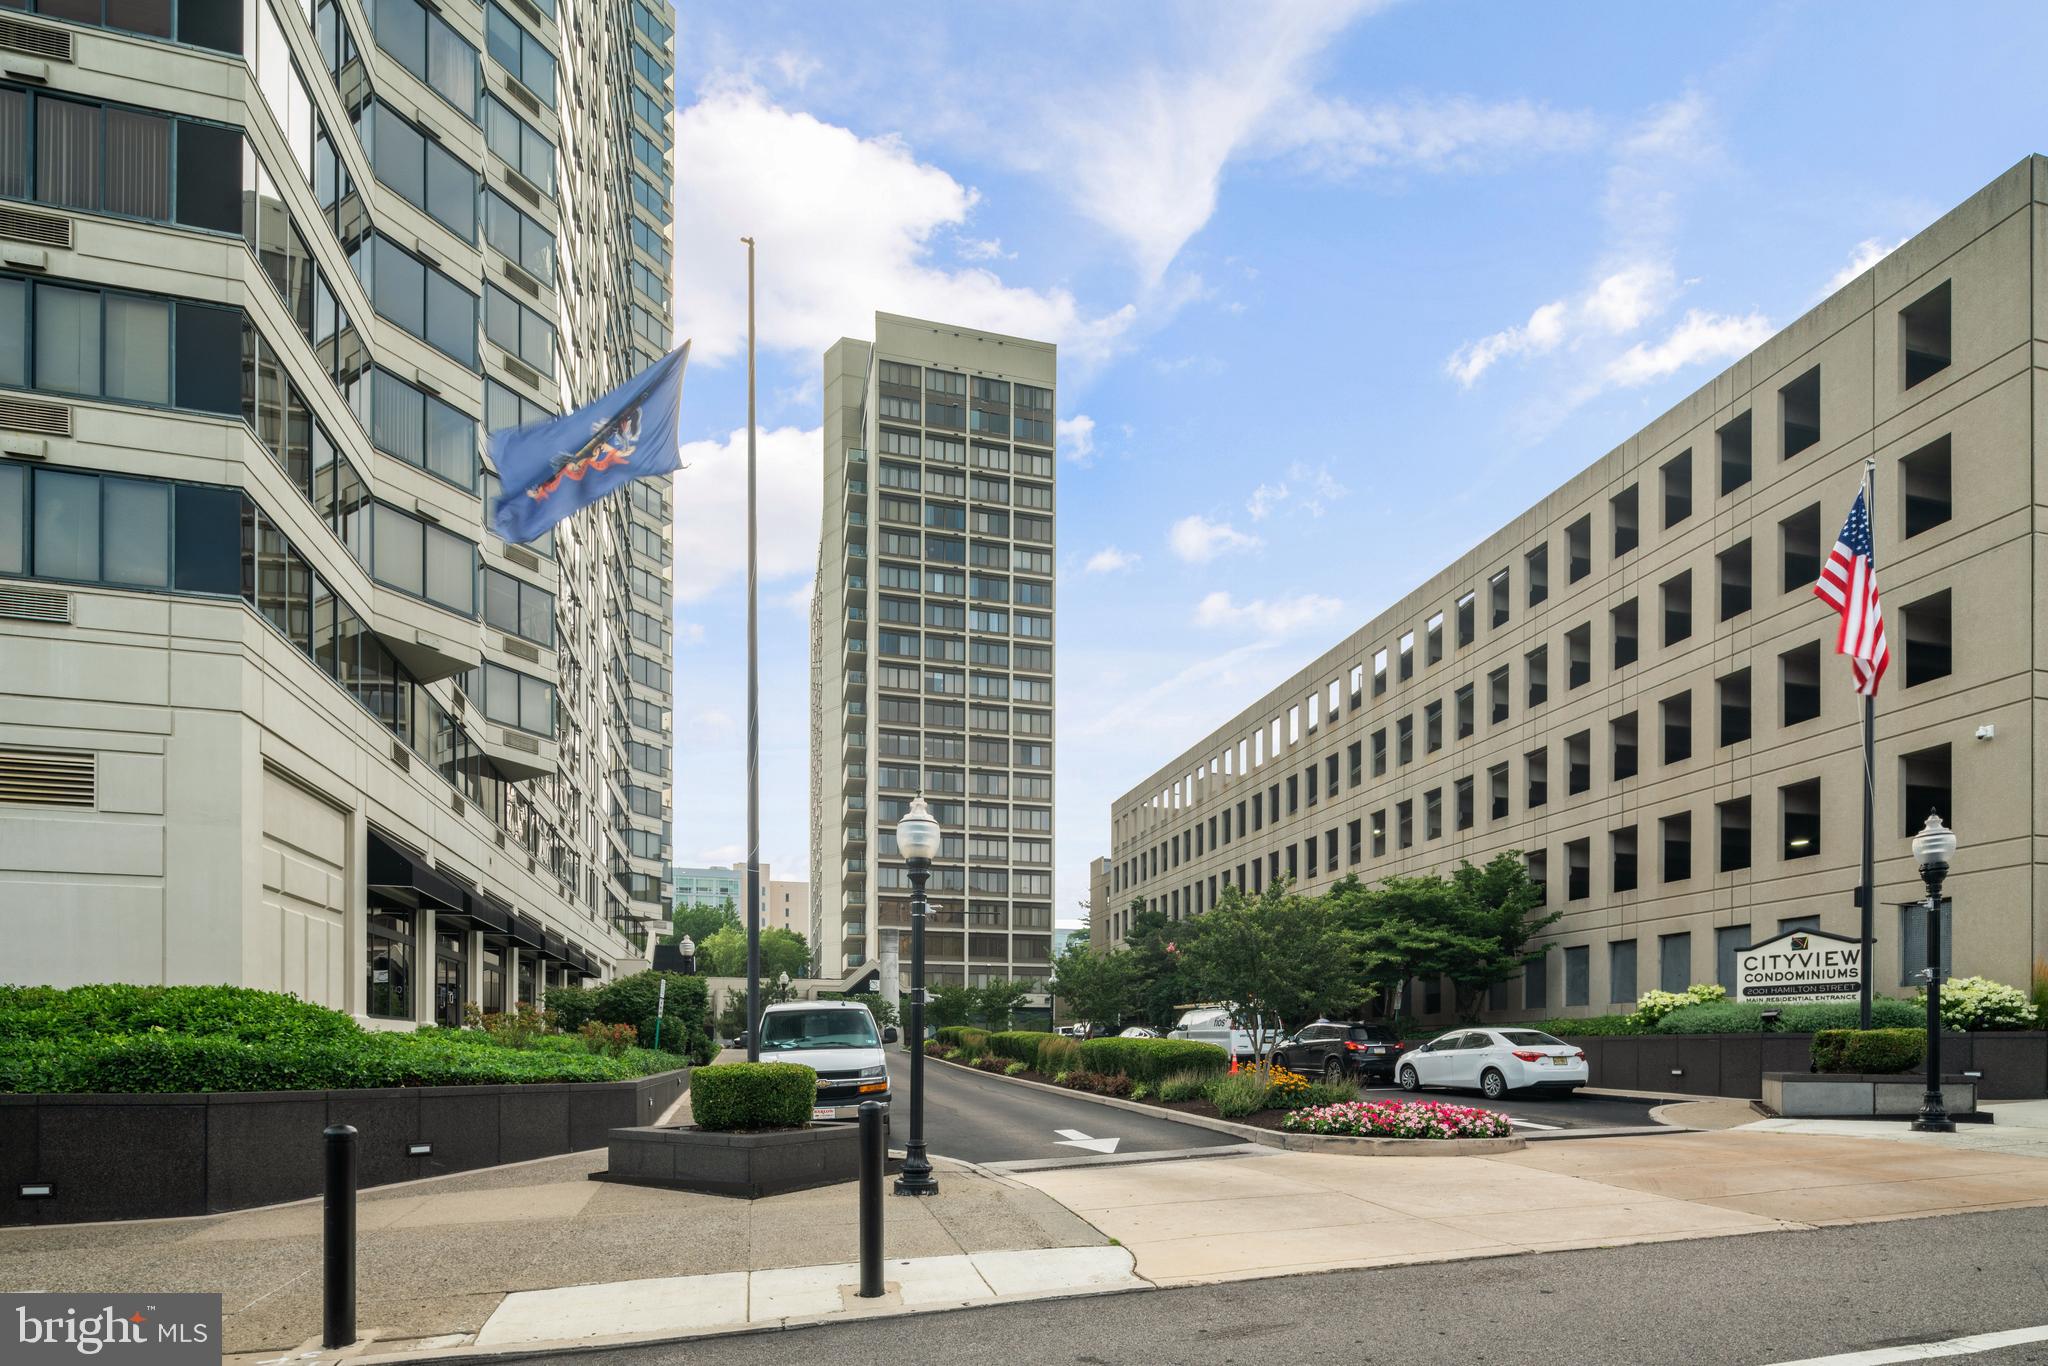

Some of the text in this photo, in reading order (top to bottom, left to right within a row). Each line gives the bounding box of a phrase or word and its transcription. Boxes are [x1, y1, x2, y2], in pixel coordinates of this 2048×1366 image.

[1744, 949, 1860, 971] CITYVIEW
[1744, 968, 1859, 983] CONDOMINIUMS
[1771, 984, 1817, 994] HAMILTON
[1819, 983, 1856, 992] STREET
